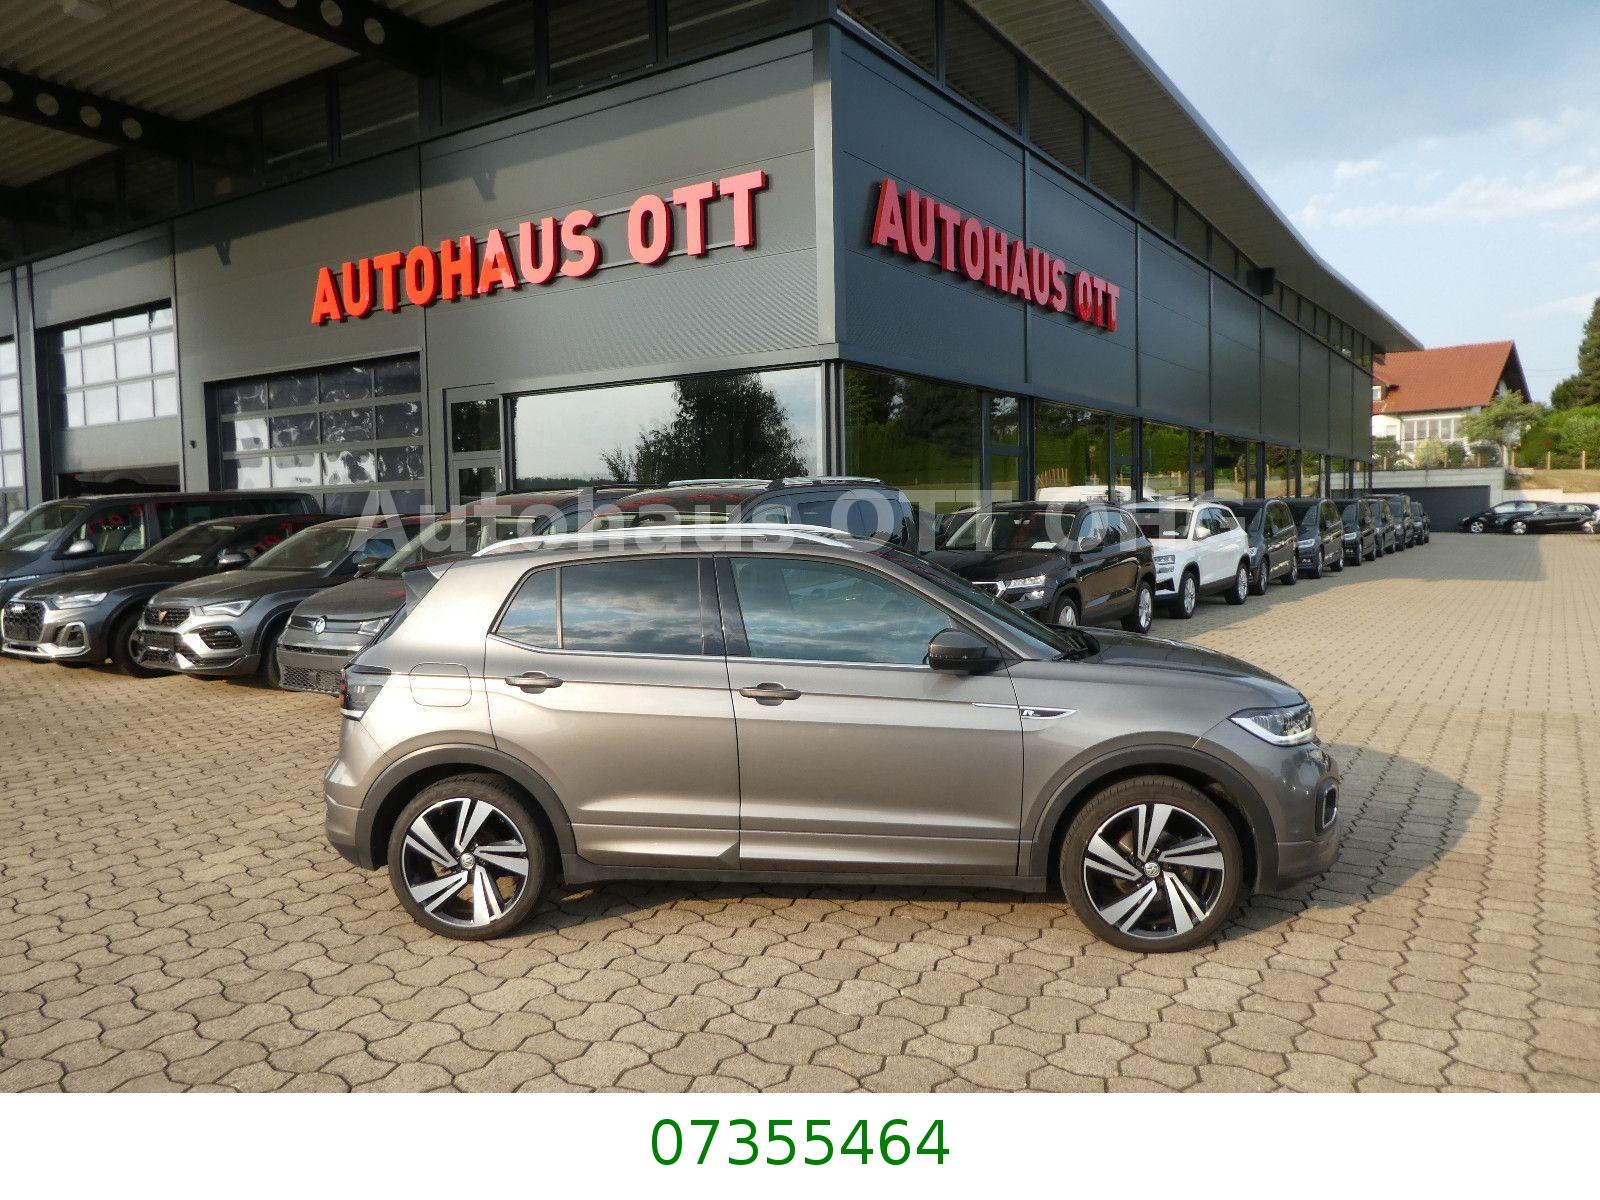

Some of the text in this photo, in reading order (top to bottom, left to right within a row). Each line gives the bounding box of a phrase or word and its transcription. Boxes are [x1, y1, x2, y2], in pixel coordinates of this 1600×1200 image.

[311, 169, 768, 326] AUTOHAUS OTT
[871, 177, 1121, 333] AUTOHAUS OTT
